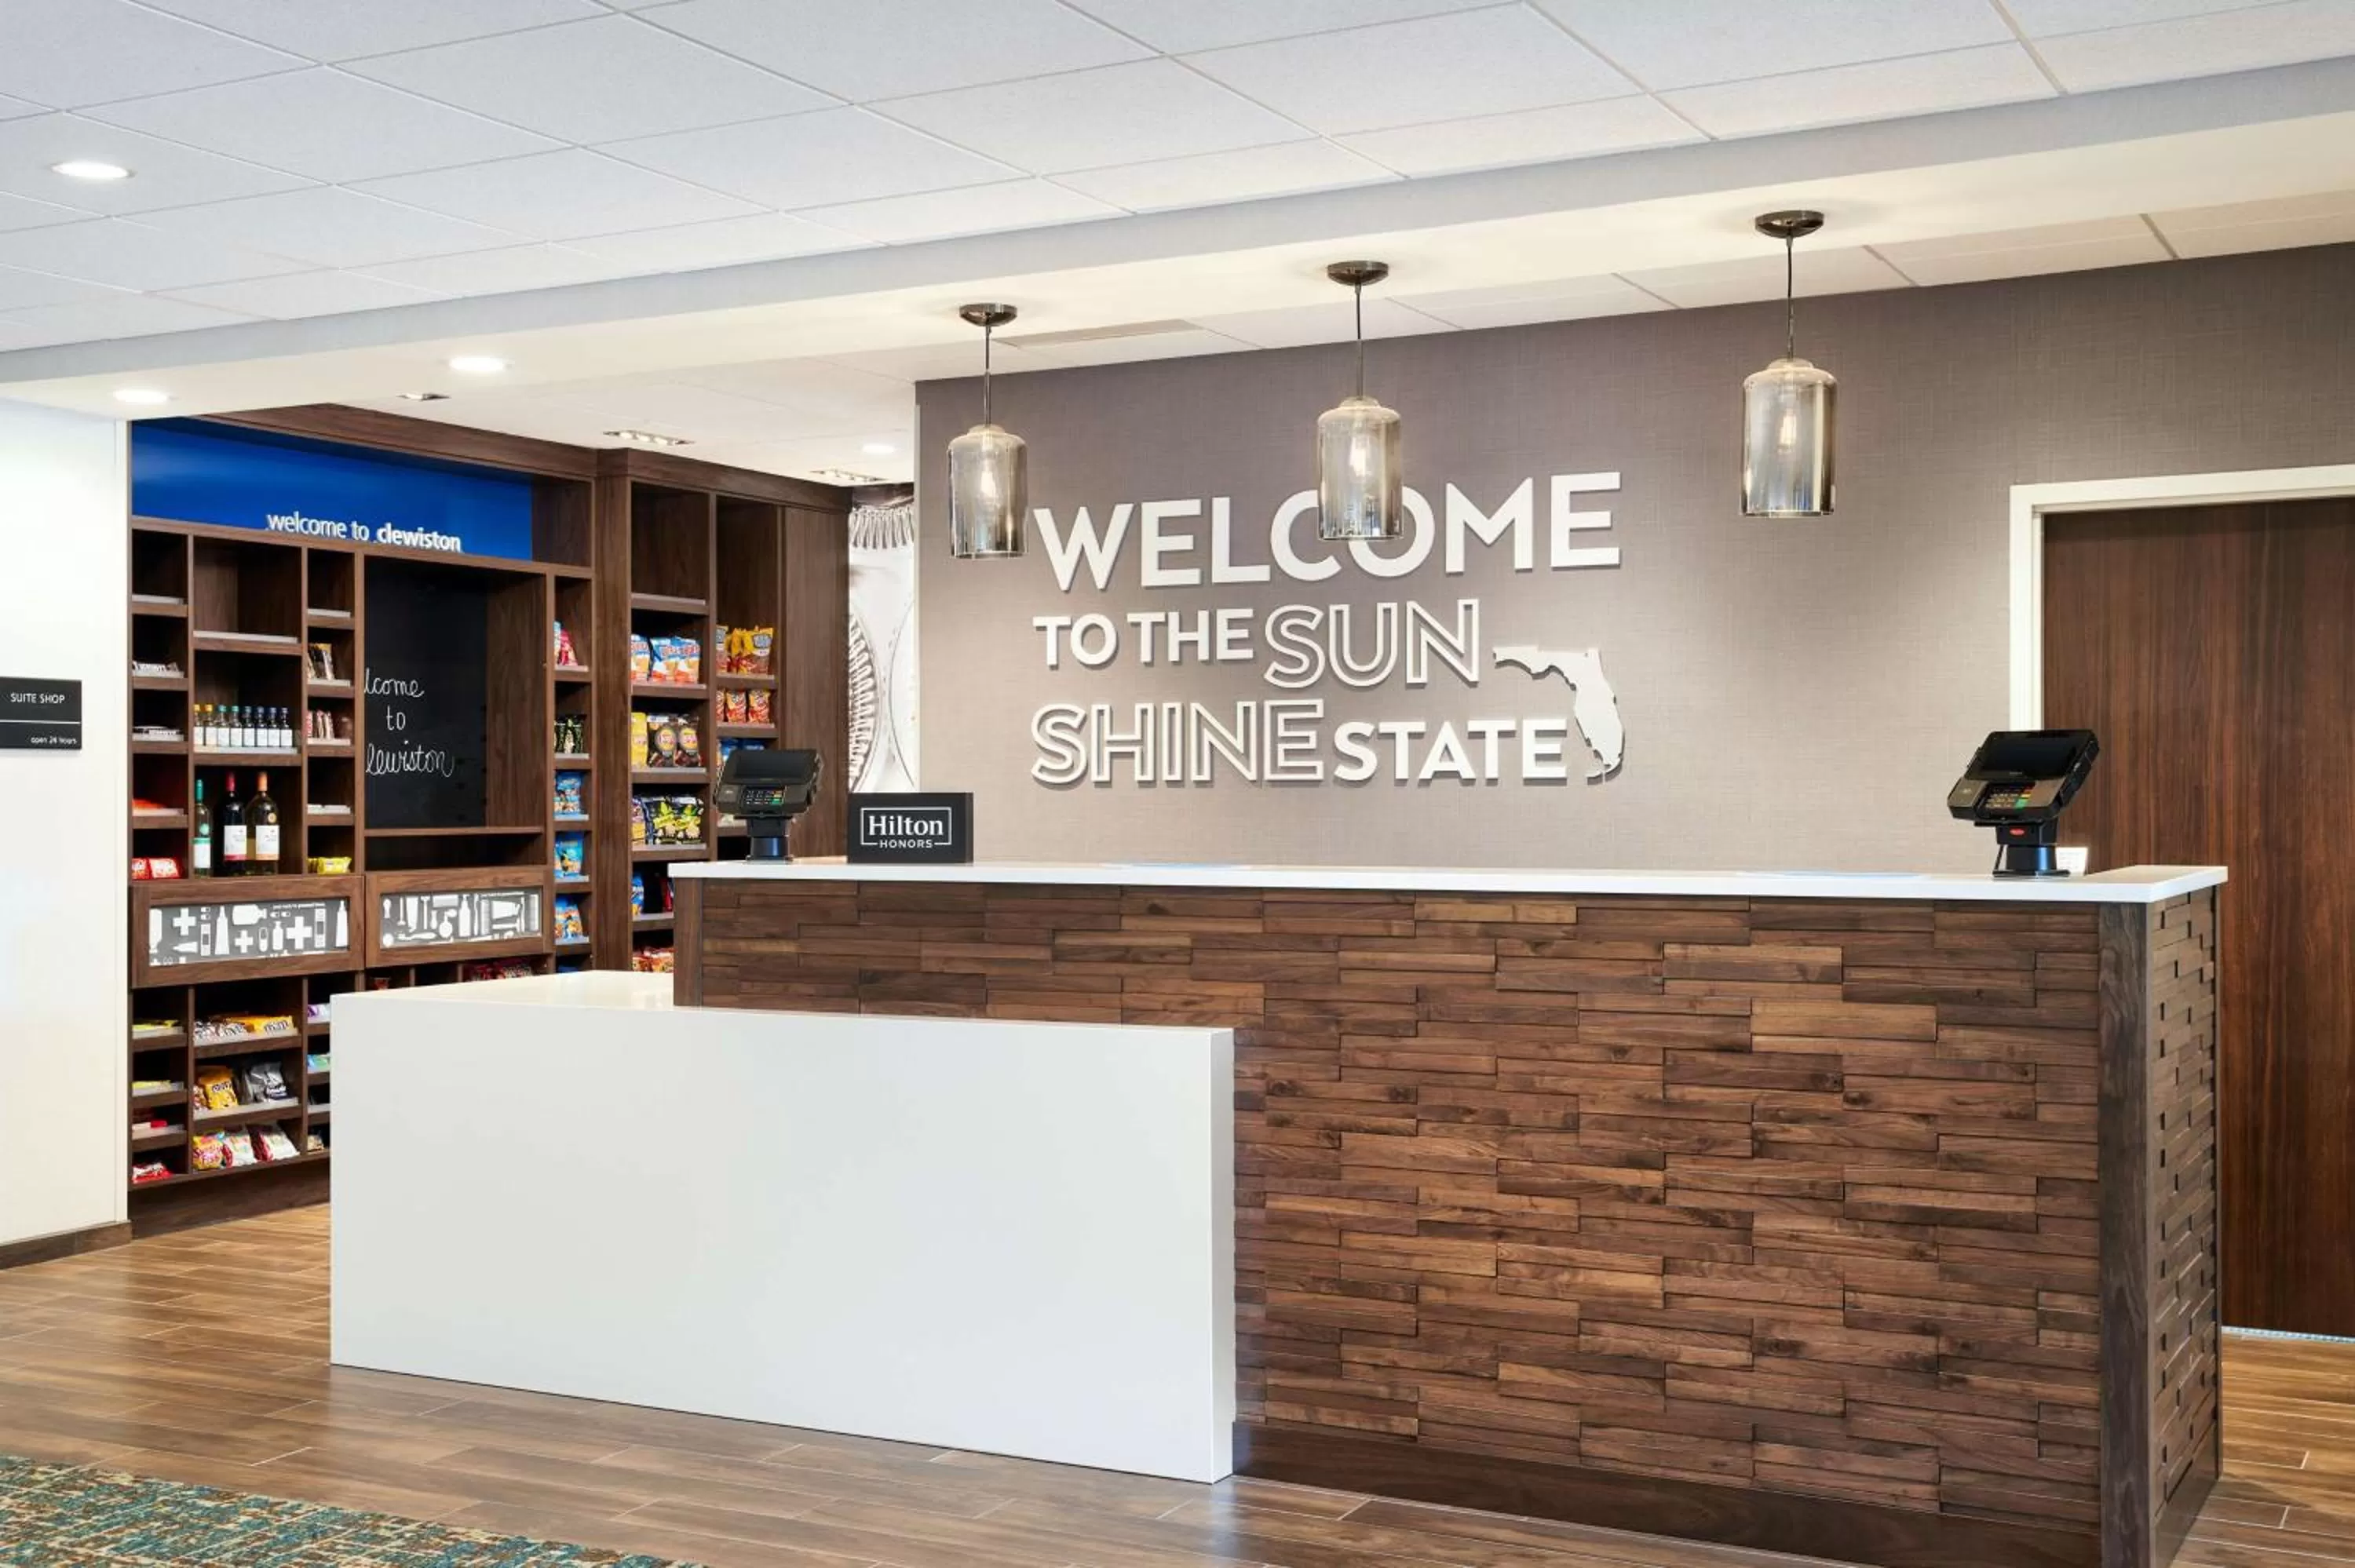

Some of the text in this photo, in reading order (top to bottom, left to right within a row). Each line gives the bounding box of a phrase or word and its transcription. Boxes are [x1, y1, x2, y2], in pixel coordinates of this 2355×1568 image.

[266, 512, 347, 539] welcome
[351, 521, 369, 541] to
[1033, 472, 1621, 591] WELCOME
[1032, 599, 1480, 688] TO THE SUN
[364, 668, 425, 697] lcome
[10, 692, 65, 704] SUITE SHOP
[386, 706, 406, 731] to
[1031, 699, 1567, 784] SHINE STATE
[366, 740, 455, 778] lewiston
[868, 815, 944, 836] Hilton
[879, 839, 933, 848] HONORS
